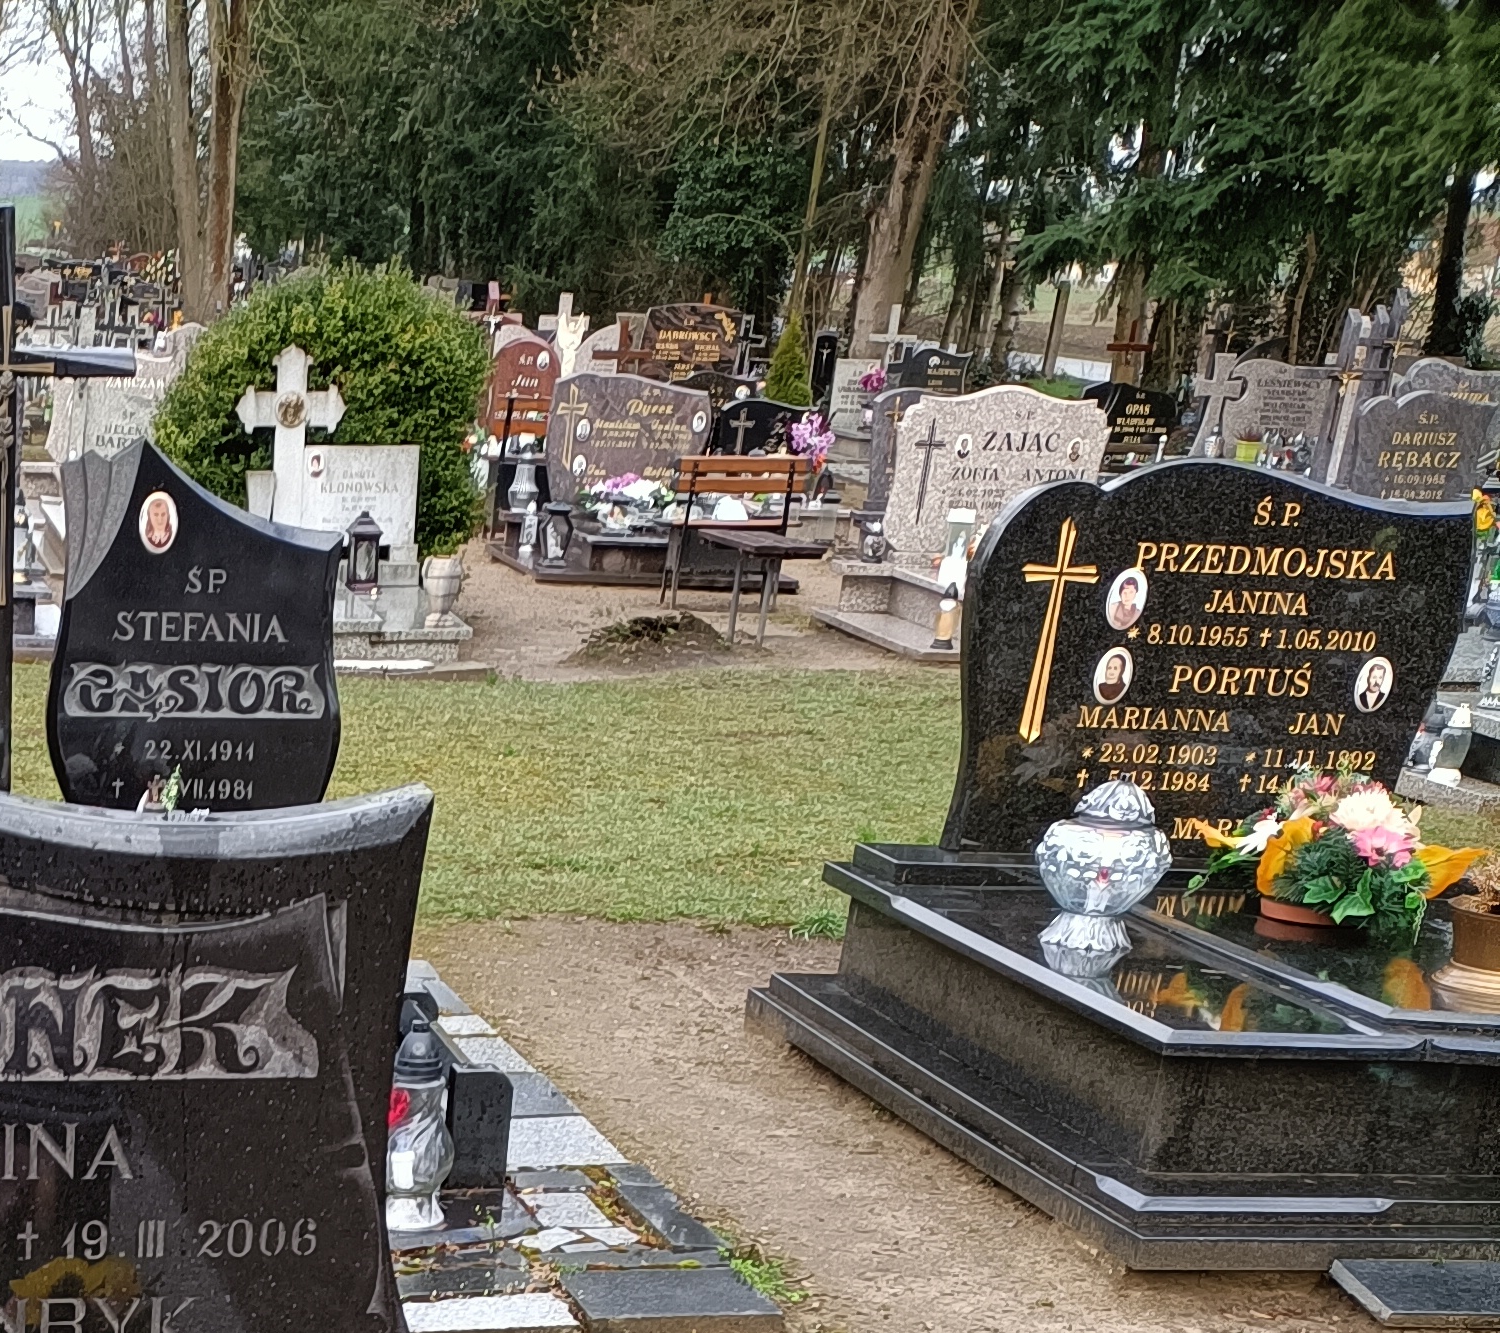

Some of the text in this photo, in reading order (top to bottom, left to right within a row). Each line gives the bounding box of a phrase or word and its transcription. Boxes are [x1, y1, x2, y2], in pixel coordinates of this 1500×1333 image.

[1125, 403, 1151, 416] OPAS
[982, 430, 1060, 457] ZAJĄC
[1391, 431, 1457, 446] DARIUSZ
[951, 466, 1086, 482] ZOFIA ANTONI
[1377, 450, 1461, 471] RĘBACZ
[320, 481, 399, 494] KLONOWSKA
[1134, 541, 1397, 581] PRZEDMOJSKA
[1204, 589, 1310, 617] JANINA
[112, 608, 289, 644] STEFANIA
[1147, 623, 1377, 653] 8.10.1955 1.05.2010
[1168, 661, 1312, 698] PORTUŚ
[1076, 705, 1345, 737] MARIANNA JAN
[143, 739, 255, 763] 22.XI.1911
[1100, 742, 1218, 767] 23.02.1903
[197, 1217, 318, 1259] 2006
